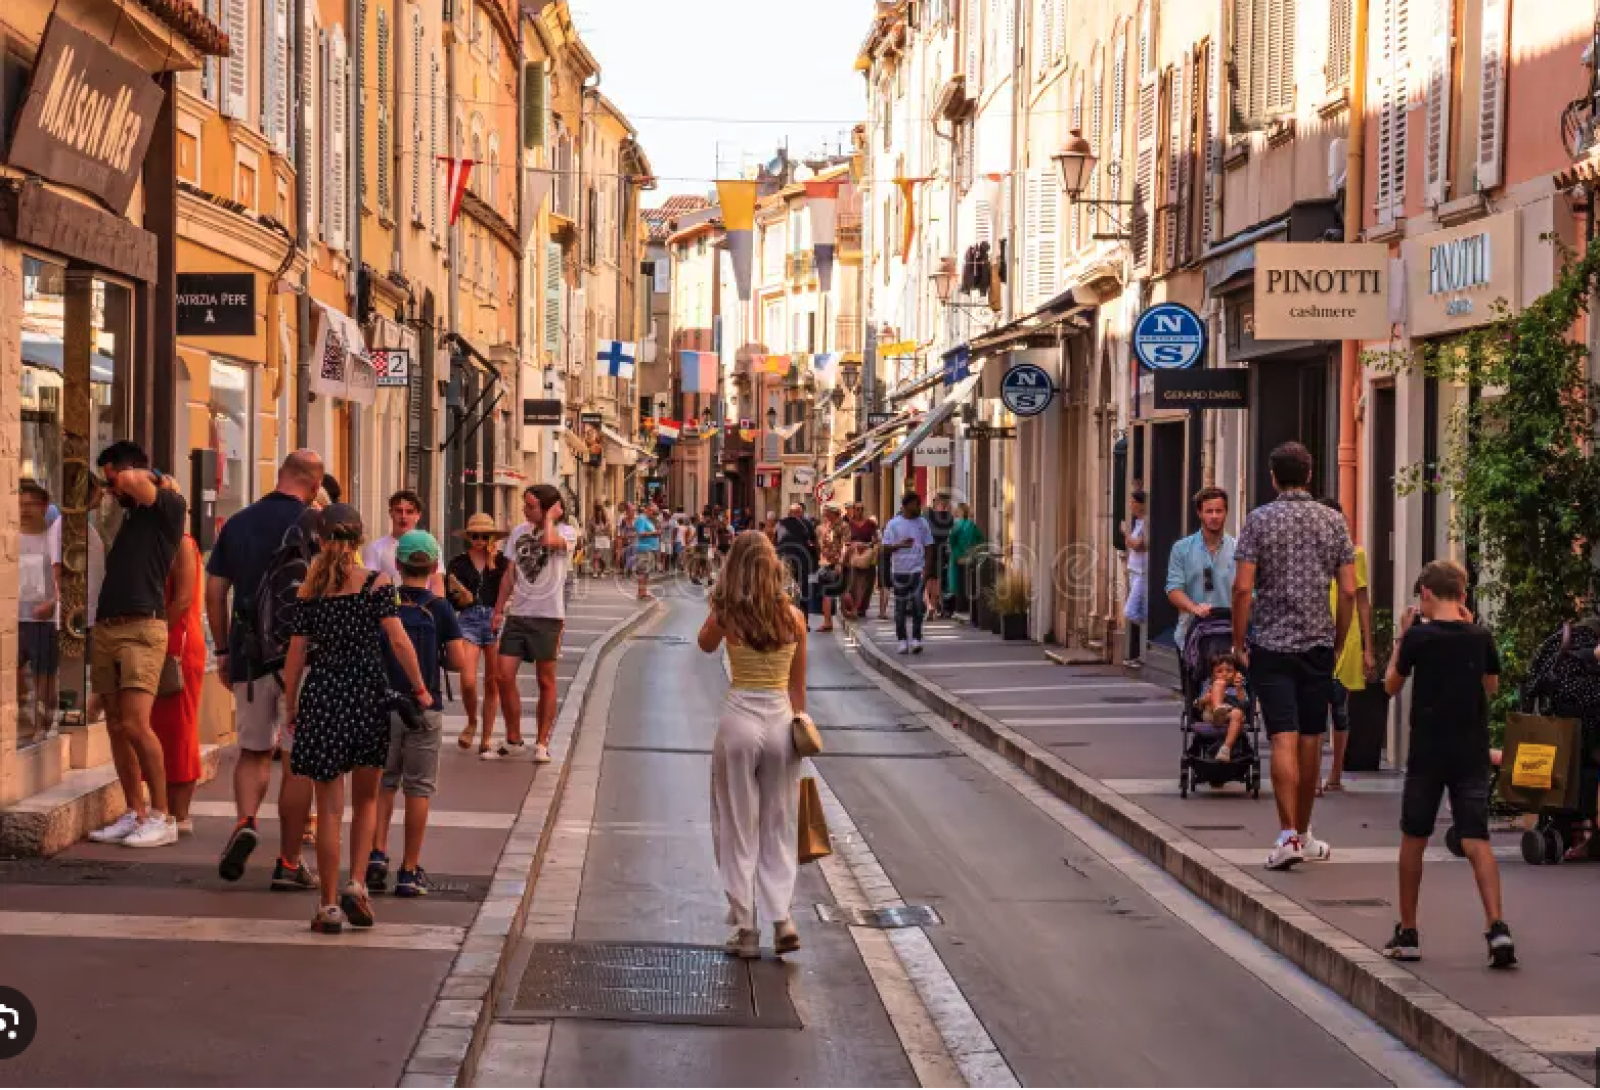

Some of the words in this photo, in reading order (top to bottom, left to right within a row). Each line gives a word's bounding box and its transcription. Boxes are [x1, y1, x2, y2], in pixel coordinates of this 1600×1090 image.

[1266, 269, 1382, 293] PINOTTI
[176, 293, 218, 306] ATRIZIA
[220, 292, 248, 306] PEPE
[1289, 304, 1358, 318] cashmere
[1153, 314, 1186, 333] N
[1153, 345, 1184, 363] S
[390, 355, 404, 373] 2
[1016, 371, 1037, 386] N
[1016, 394, 1037, 408] S
[1163, 389, 1208, 400] GERARD
